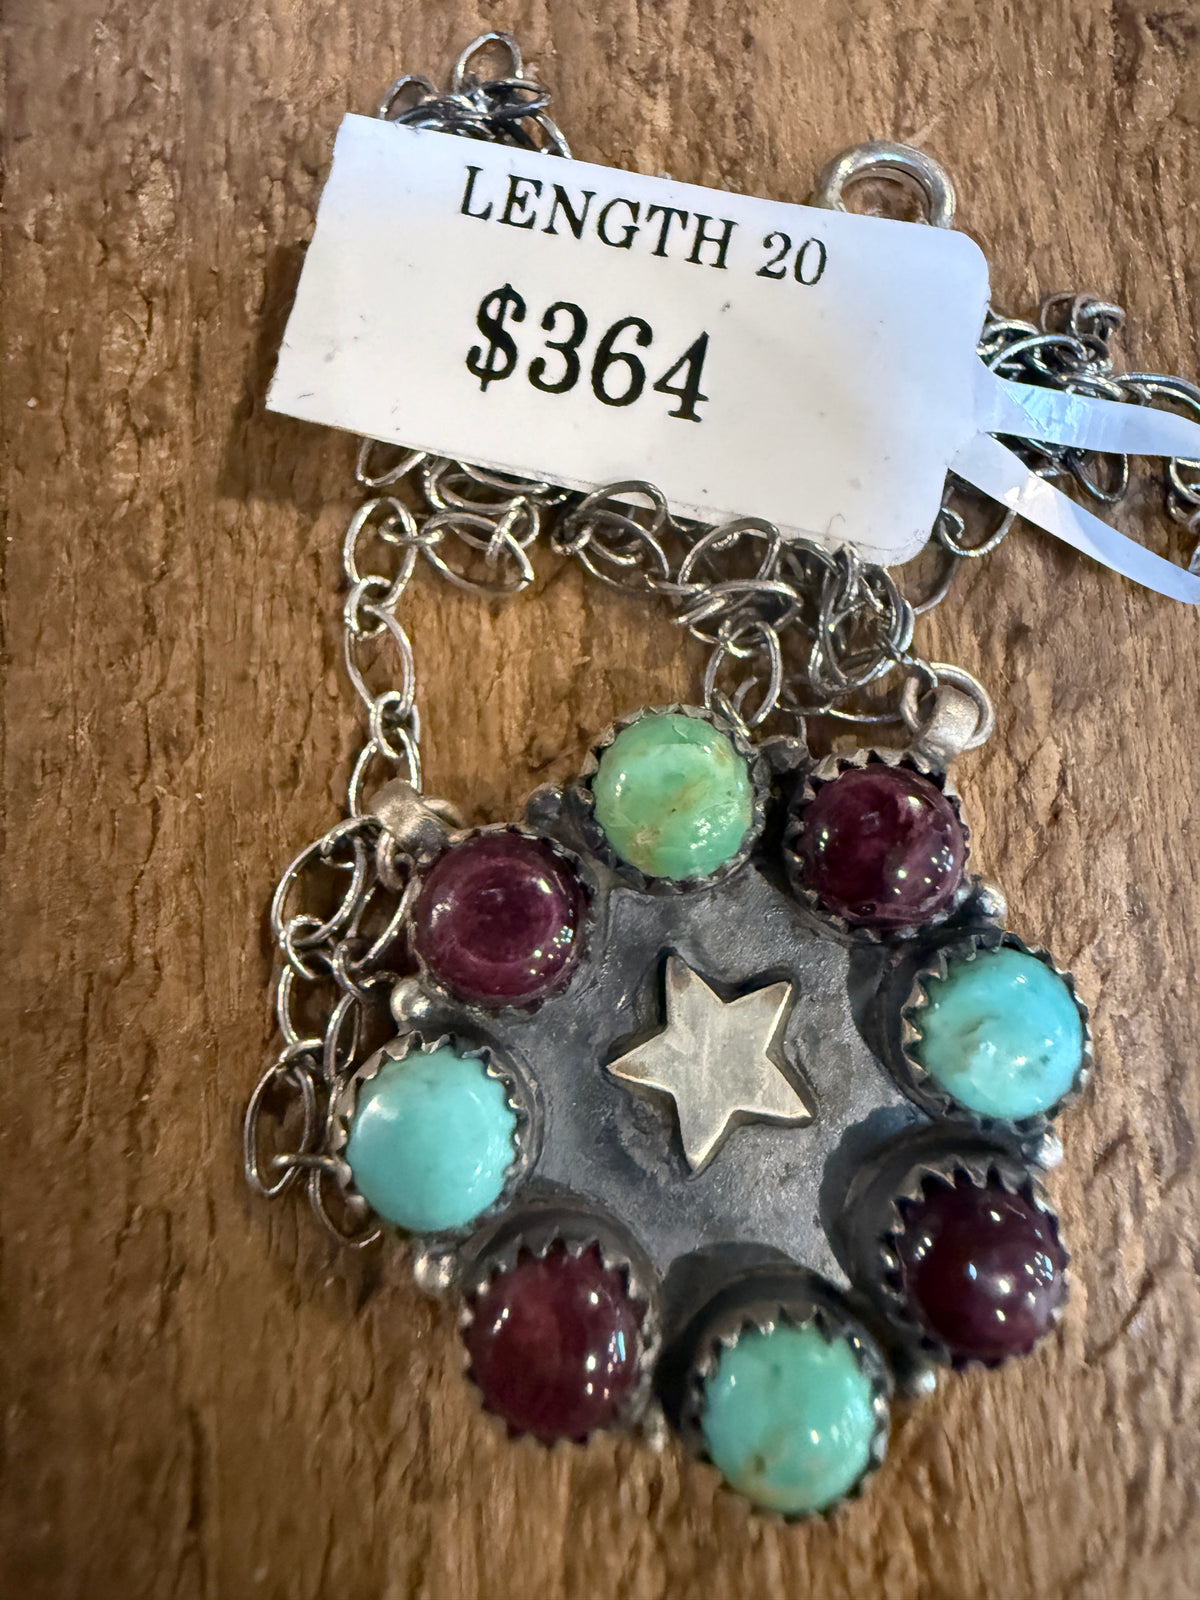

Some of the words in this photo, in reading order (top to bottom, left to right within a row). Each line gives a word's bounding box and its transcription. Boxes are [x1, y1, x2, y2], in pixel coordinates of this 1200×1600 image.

[460, 165, 738, 270] LENGTH
[756, 231, 828, 286] 20
[465, 282, 710, 423] $364
